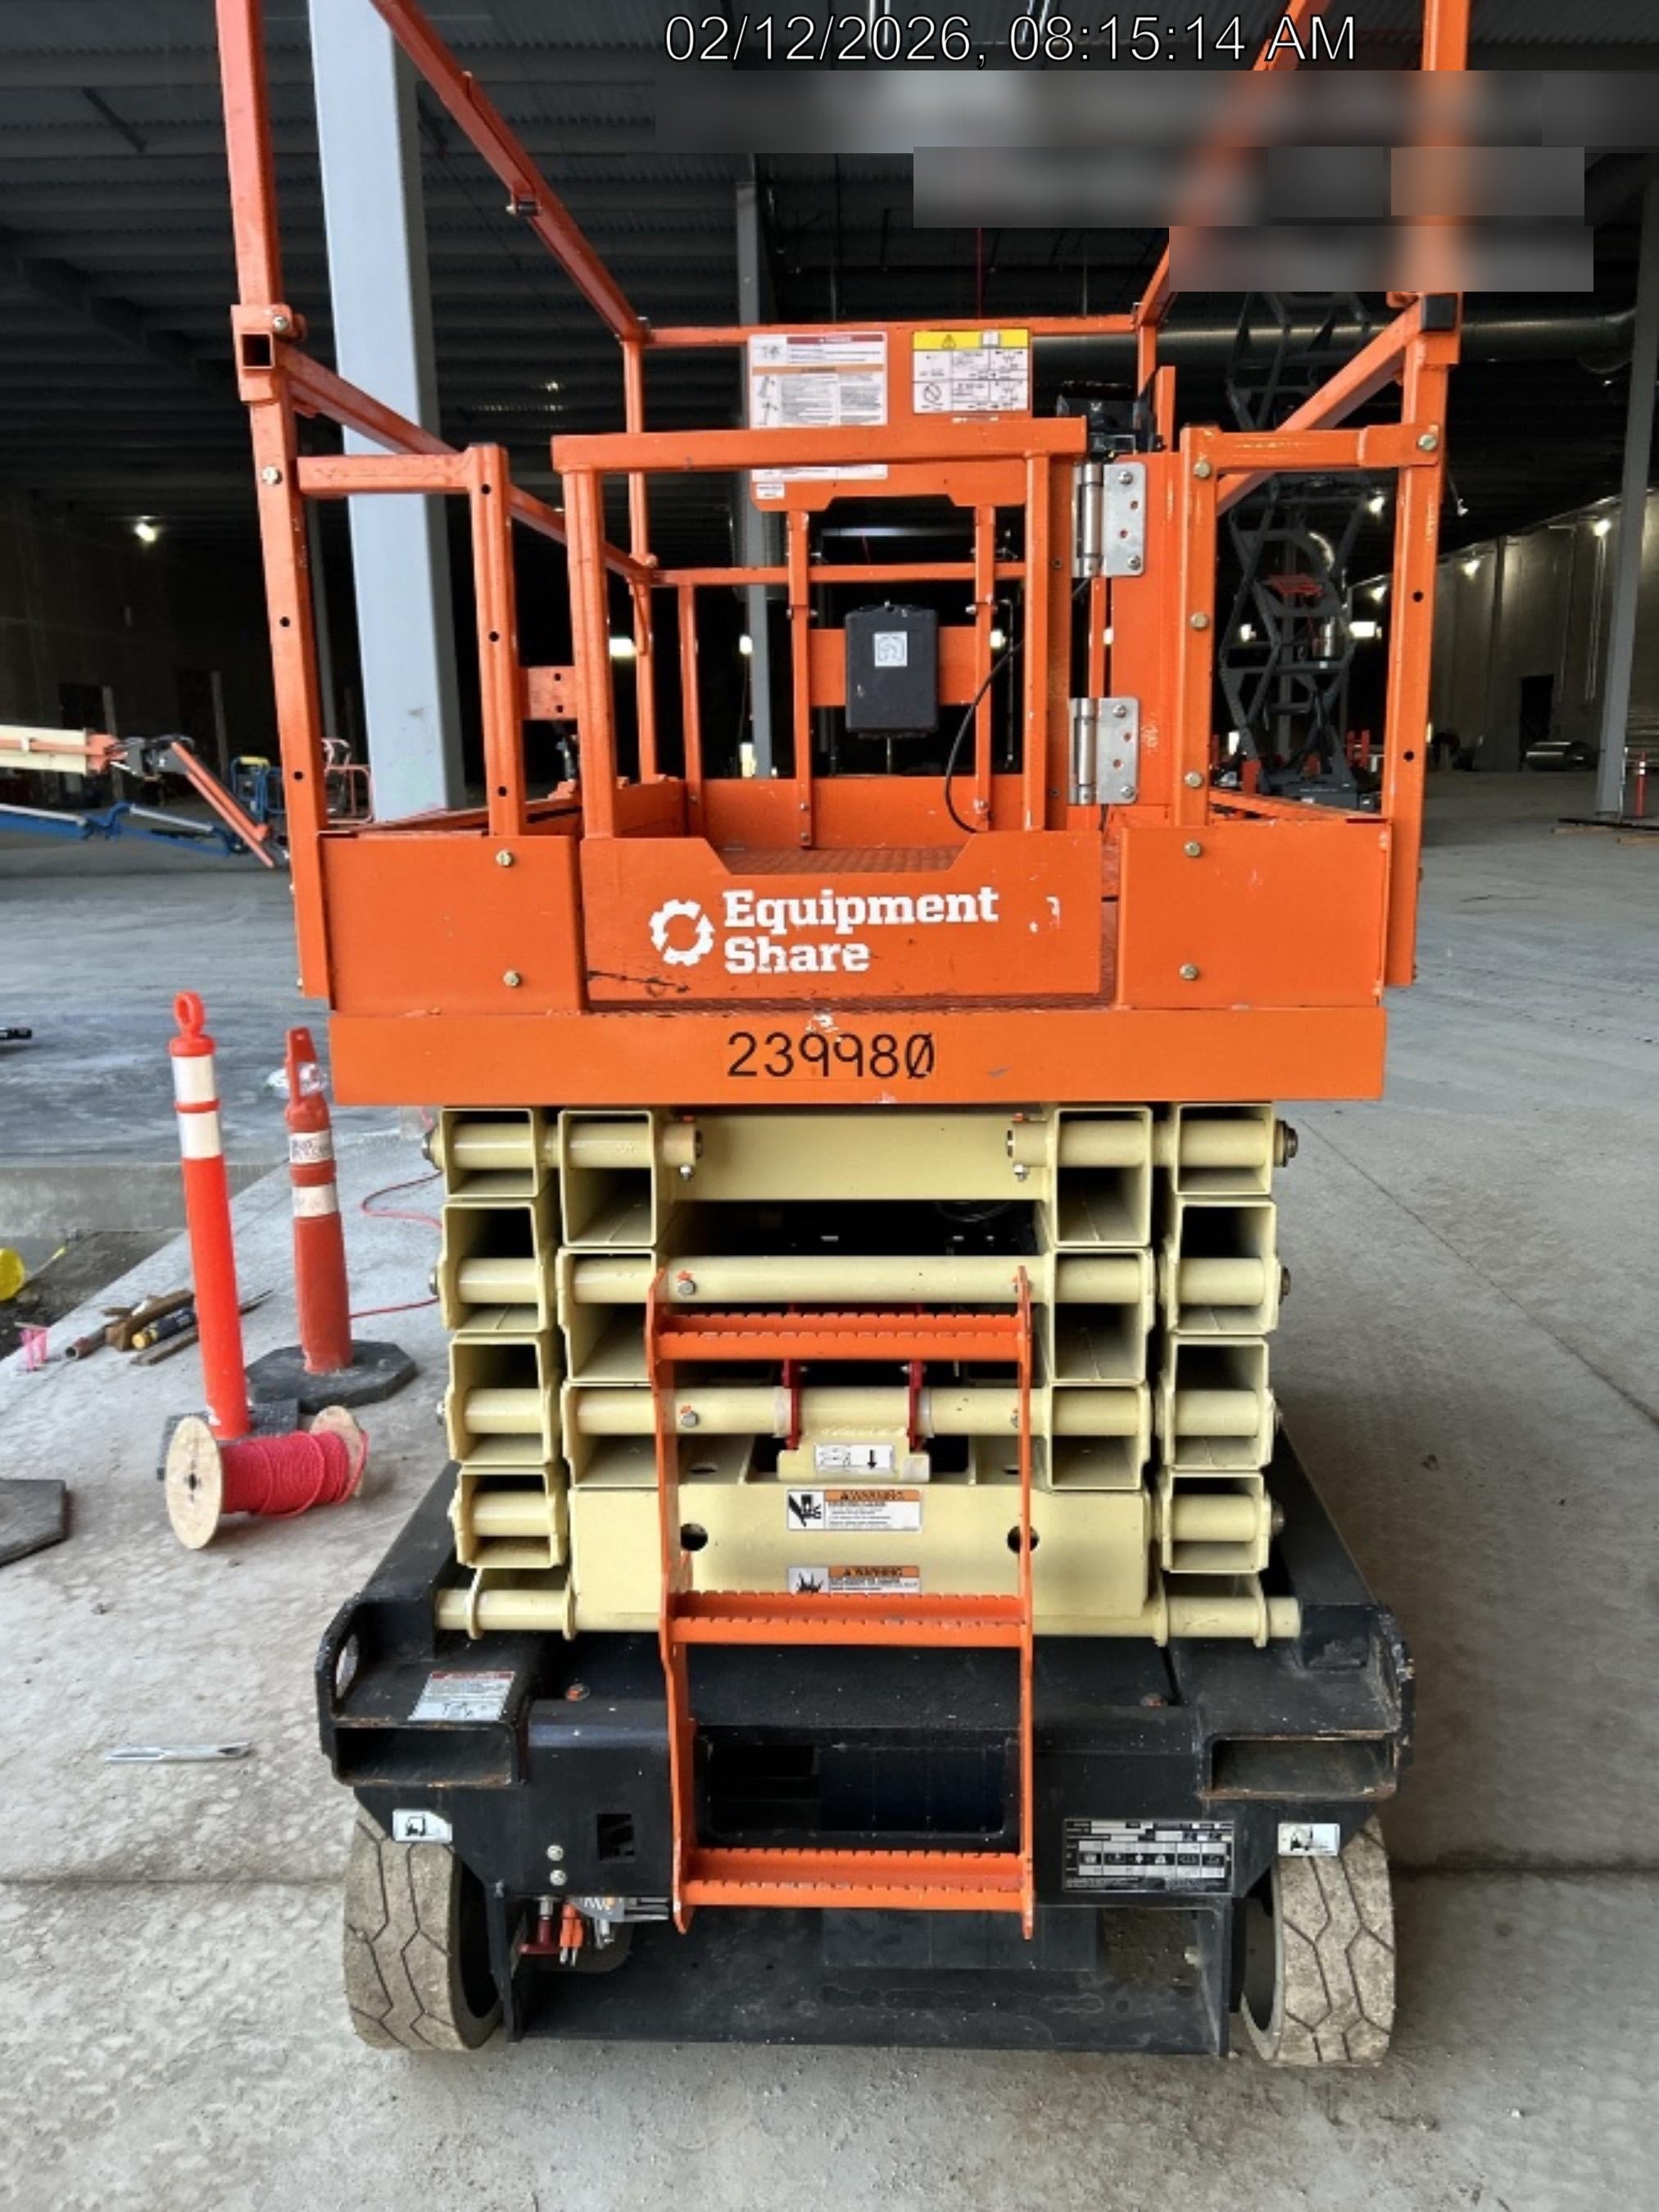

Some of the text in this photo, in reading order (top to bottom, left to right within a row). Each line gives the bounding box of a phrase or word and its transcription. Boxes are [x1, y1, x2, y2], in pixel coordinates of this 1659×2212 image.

[723, 887, 999, 936] Equipment
[724, 936, 871, 974] Share
[728, 1031, 936, 1080] 239980
